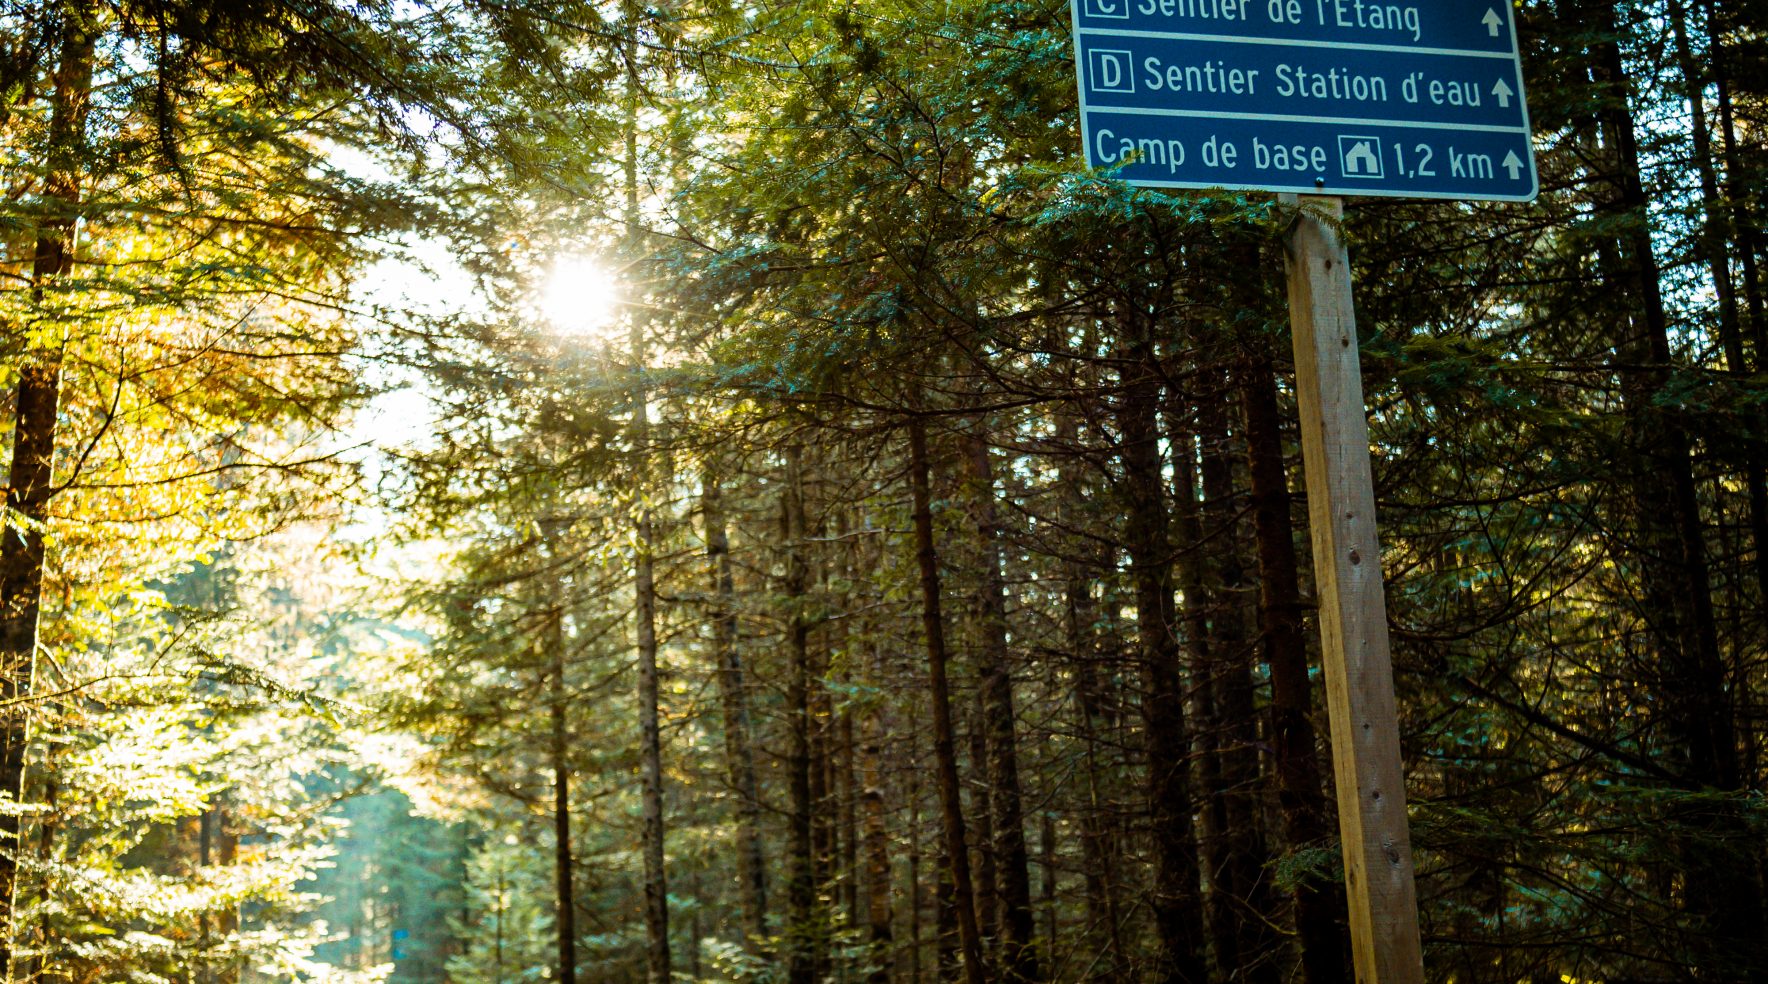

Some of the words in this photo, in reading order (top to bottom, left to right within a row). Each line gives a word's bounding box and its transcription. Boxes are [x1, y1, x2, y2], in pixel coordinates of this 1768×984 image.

[1267, 0, 1302, 25] de
[1101, 54, 1121, 87] D
[1144, 56, 1259, 95] Sentier
[1275, 63, 1387, 102] Station
[1402, 71, 1481, 107] d'eau
[1096, 128, 1185, 175] Camp
[1202, 134, 1237, 169] de
[1252, 136, 1327, 173] base
[1393, 142, 1436, 179] 1,2
[1448, 145, 1494, 180] km
